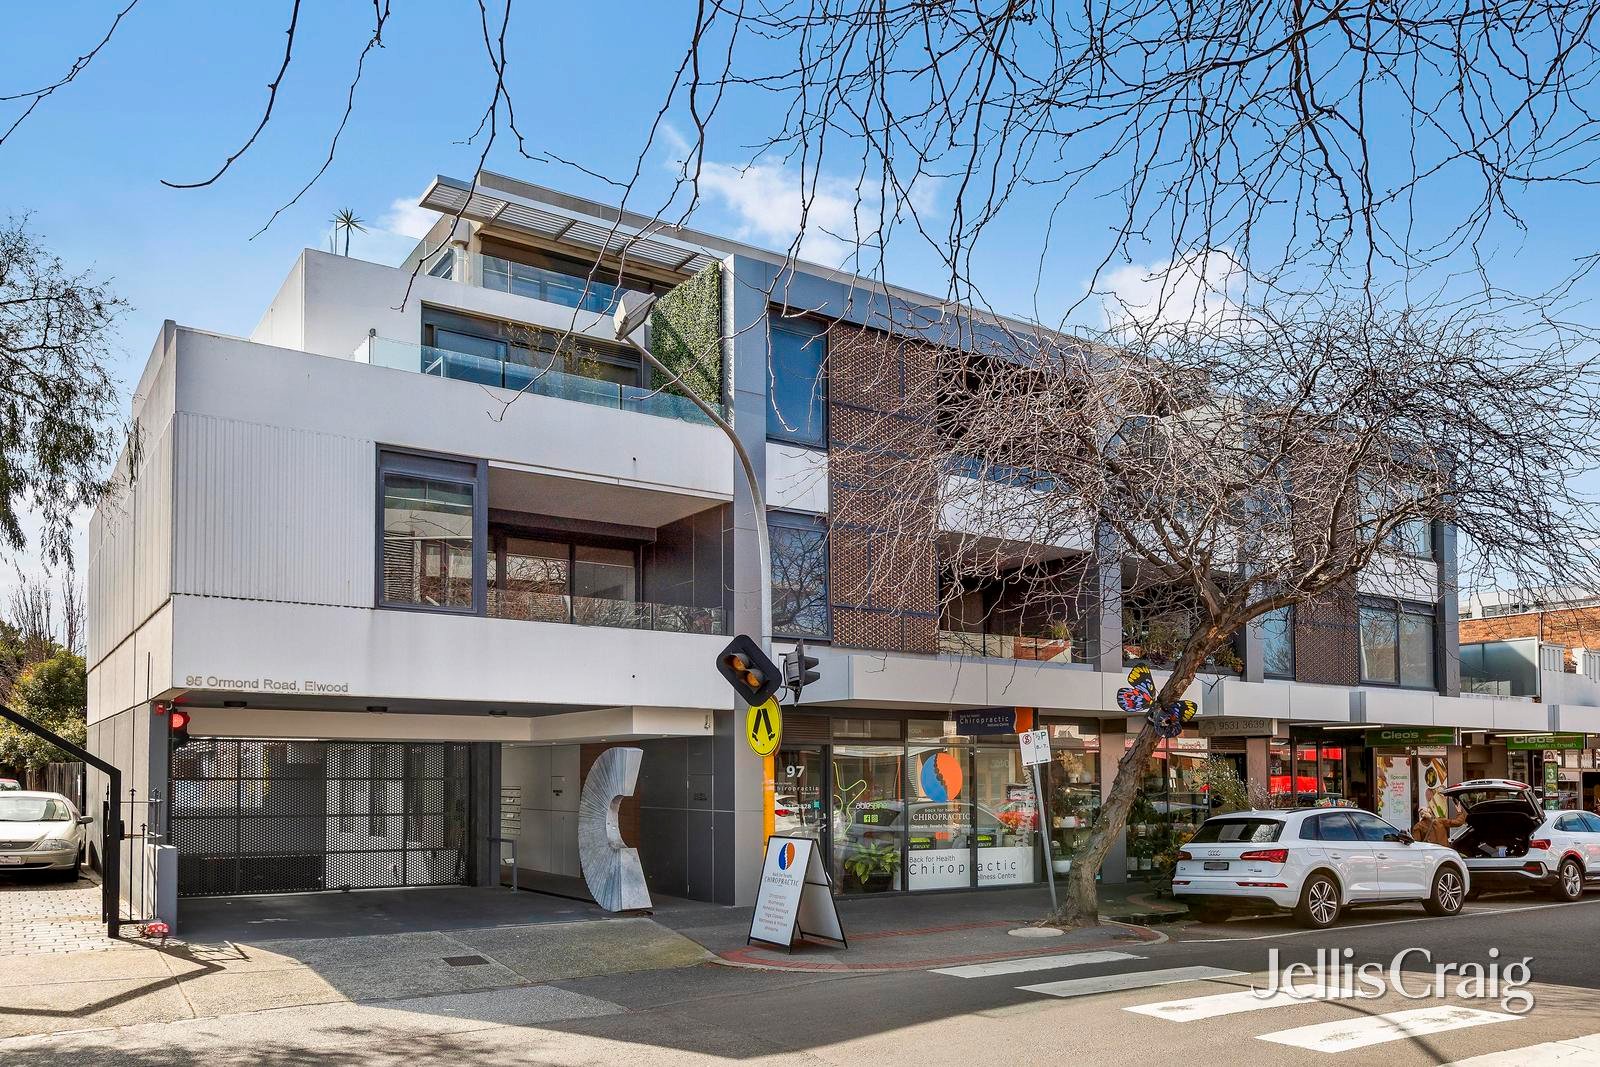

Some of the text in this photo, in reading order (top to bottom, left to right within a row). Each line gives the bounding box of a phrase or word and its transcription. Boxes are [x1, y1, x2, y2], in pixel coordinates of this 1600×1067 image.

[185, 675, 349, 693] 95 Ormond Road, Elwood
[959, 715, 1009, 725] Chiropractic
[1381, 730, 1419, 739] Cleo's
[786, 765, 805, 778] 97
[912, 812, 971, 821] CHIROPRACTIC
[925, 855, 935, 863] for
[936, 854, 956, 862] Health
[997, 871, 1017, 880] Centre
